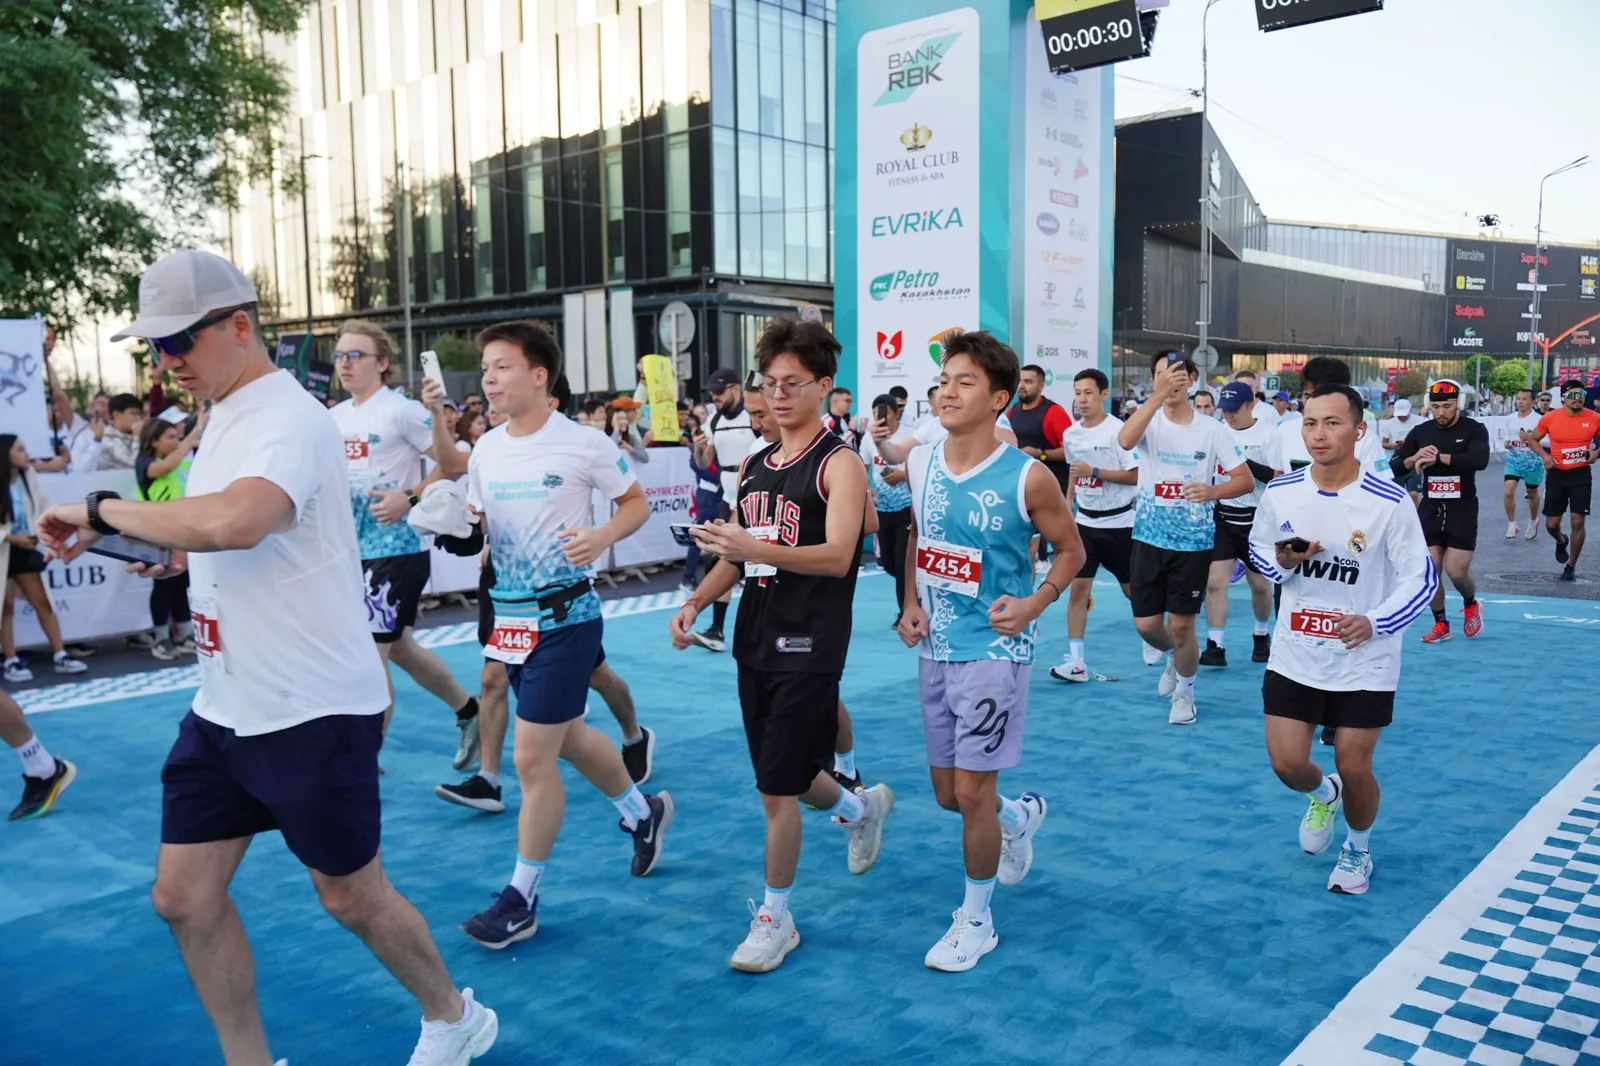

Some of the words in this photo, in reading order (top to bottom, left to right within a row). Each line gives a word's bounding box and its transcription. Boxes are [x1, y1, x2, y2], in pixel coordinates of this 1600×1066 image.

[1048, 18, 1133, 55] 00:00:30
[888, 43, 943, 69] BANK
[888, 61, 944, 91] RBK
[876, 157, 917, 175] ROYAL
[922, 151, 959, 168] CLUB
[888, 175, 919, 187] FITNESS
[930, 172, 944, 180] SPA
[893, 270, 939, 290] Petro
[900, 288, 971, 299] Kazakhstan
[1455, 304, 1485, 319] Sulpak
[1453, 338, 1483, 347] LACOSTE
[1566, 451, 1584, 460] 7447
[1160, 485, 1184, 496] 711
[1432, 483, 1455, 491] 7285
[925, 553, 972, 578] 7454
[1295, 556, 1359, 585] win
[48, 565, 106, 589] LUB
[1300, 615, 1339, 633] 730
[970, 698, 1009, 754] 23
